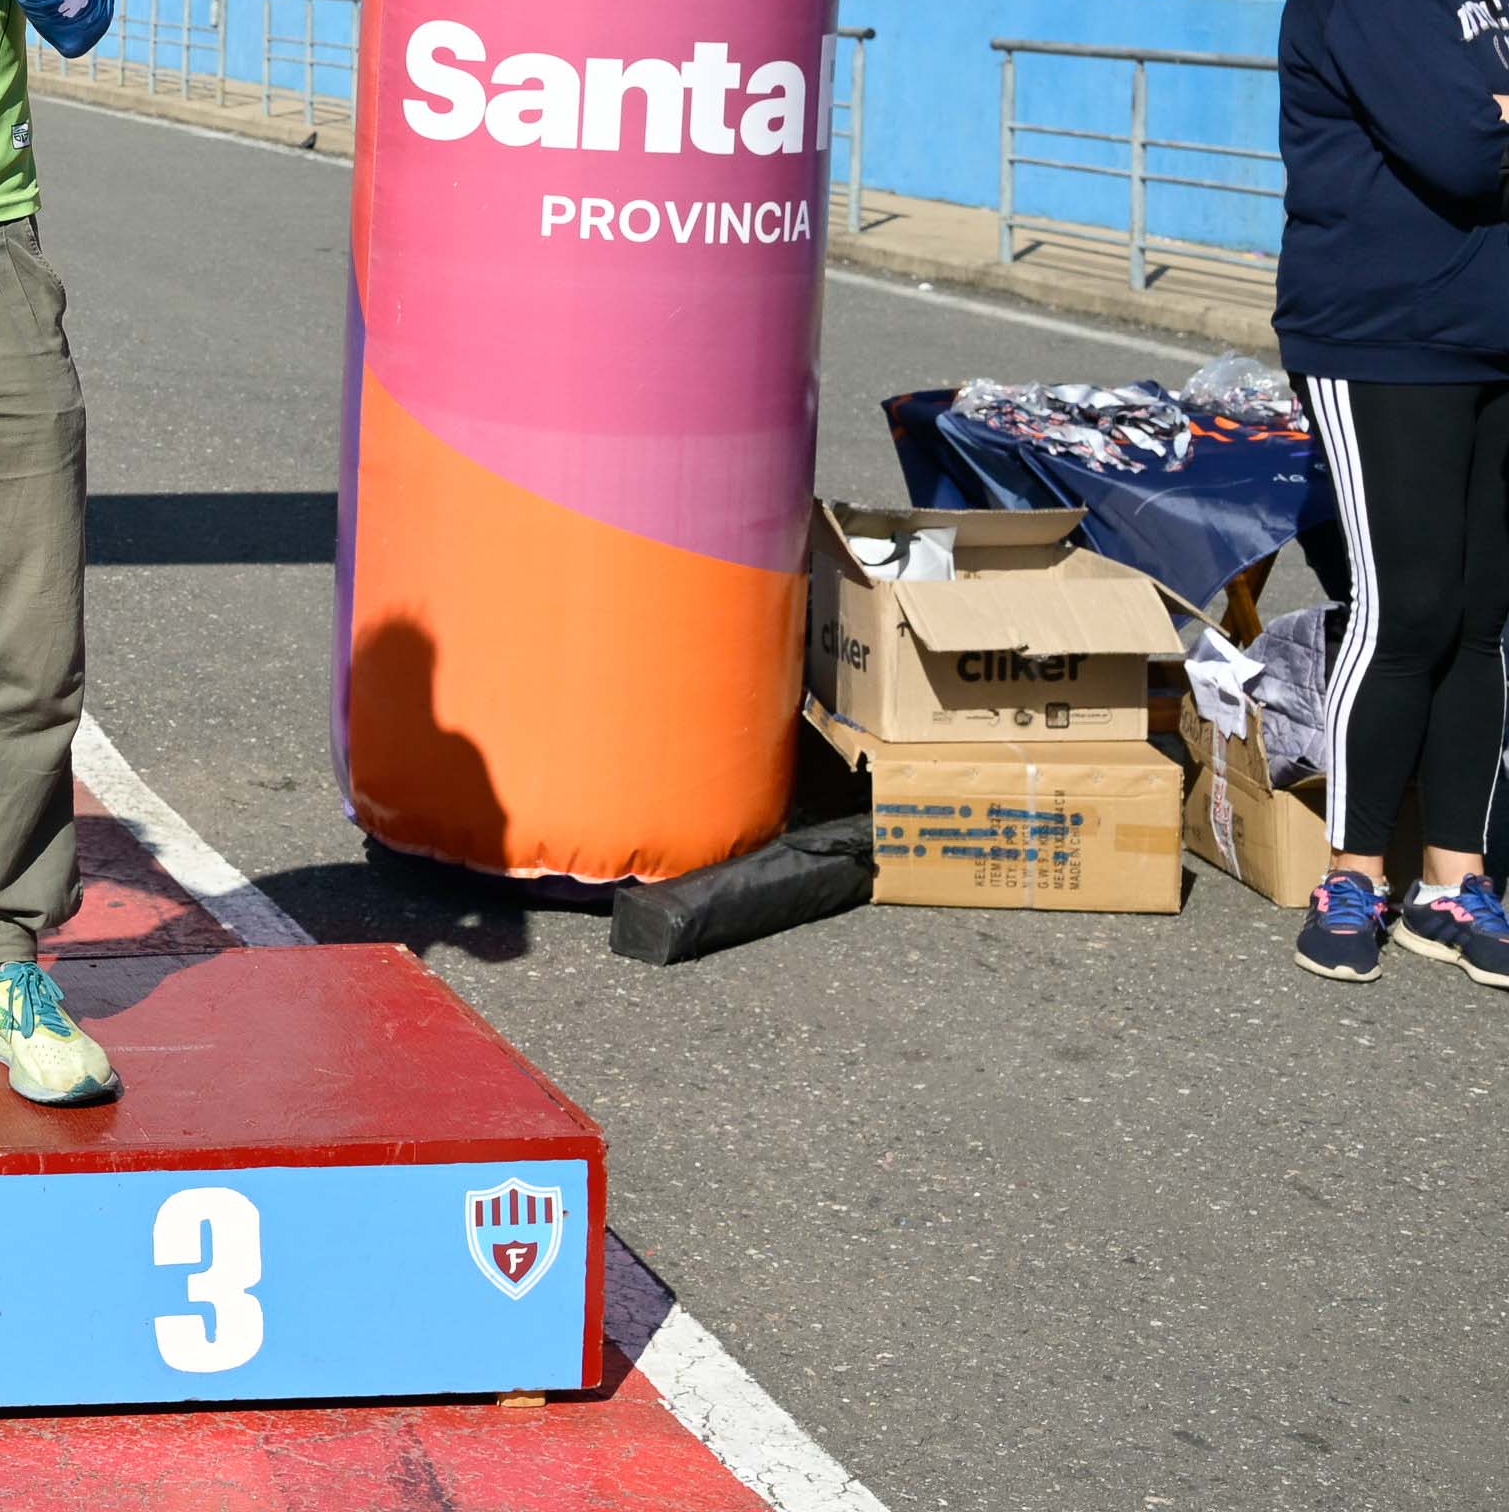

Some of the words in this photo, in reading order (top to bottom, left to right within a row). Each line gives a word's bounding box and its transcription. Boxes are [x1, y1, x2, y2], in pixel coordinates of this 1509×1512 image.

[402, 19, 807, 156] Santa
[540, 194, 812, 245] PROVINCIA
[152, 1185, 265, 1374] 3
